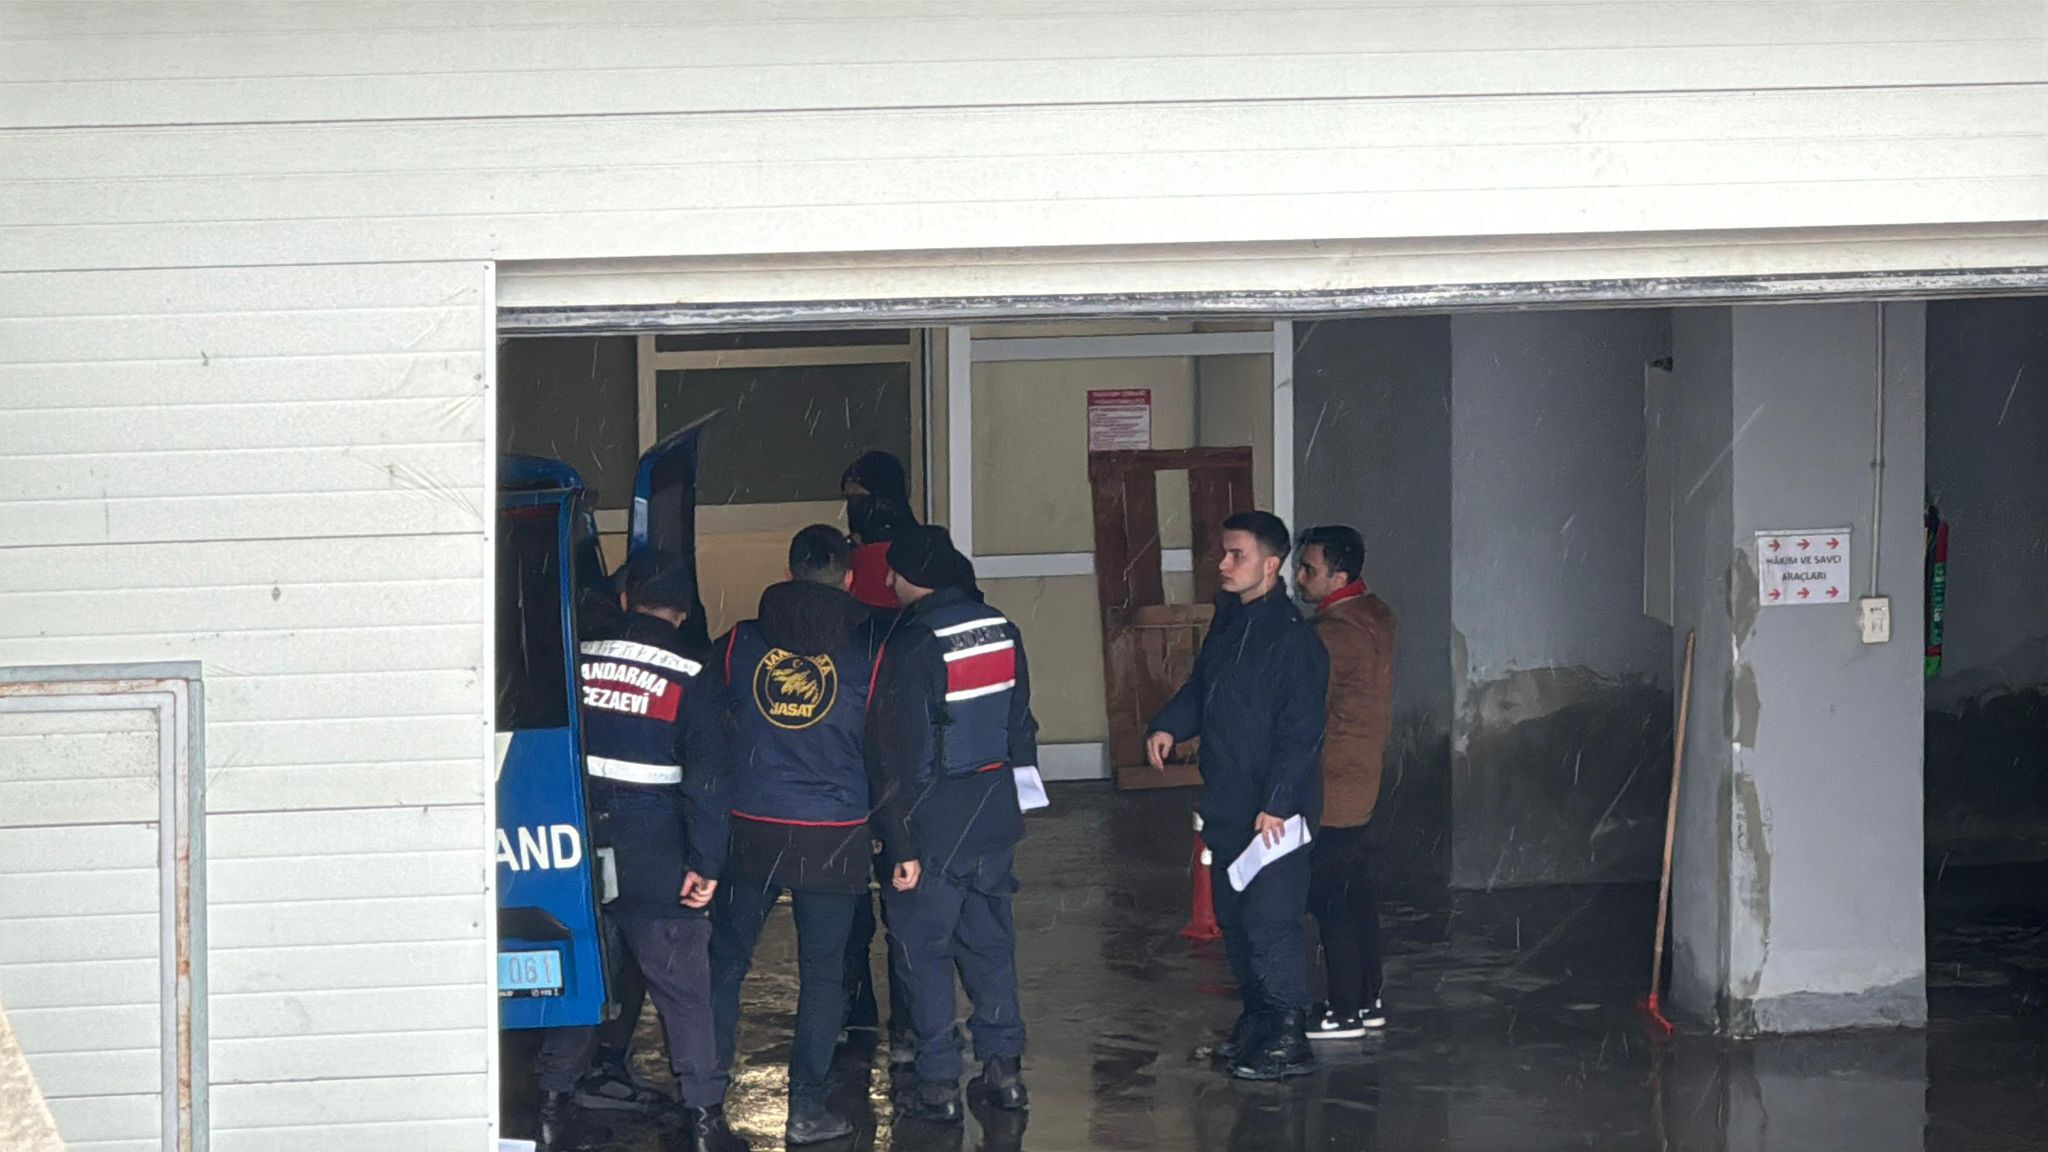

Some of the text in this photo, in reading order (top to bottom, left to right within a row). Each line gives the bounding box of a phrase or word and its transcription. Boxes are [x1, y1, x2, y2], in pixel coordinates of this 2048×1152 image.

[1800, 555, 1812, 565] VE
[1814, 554, 1842, 565] SAVCI
[1782, 571, 1827, 582] ARAÇLARI
[769, 702, 815, 718] JASAT
[496, 824, 582, 871] AND
